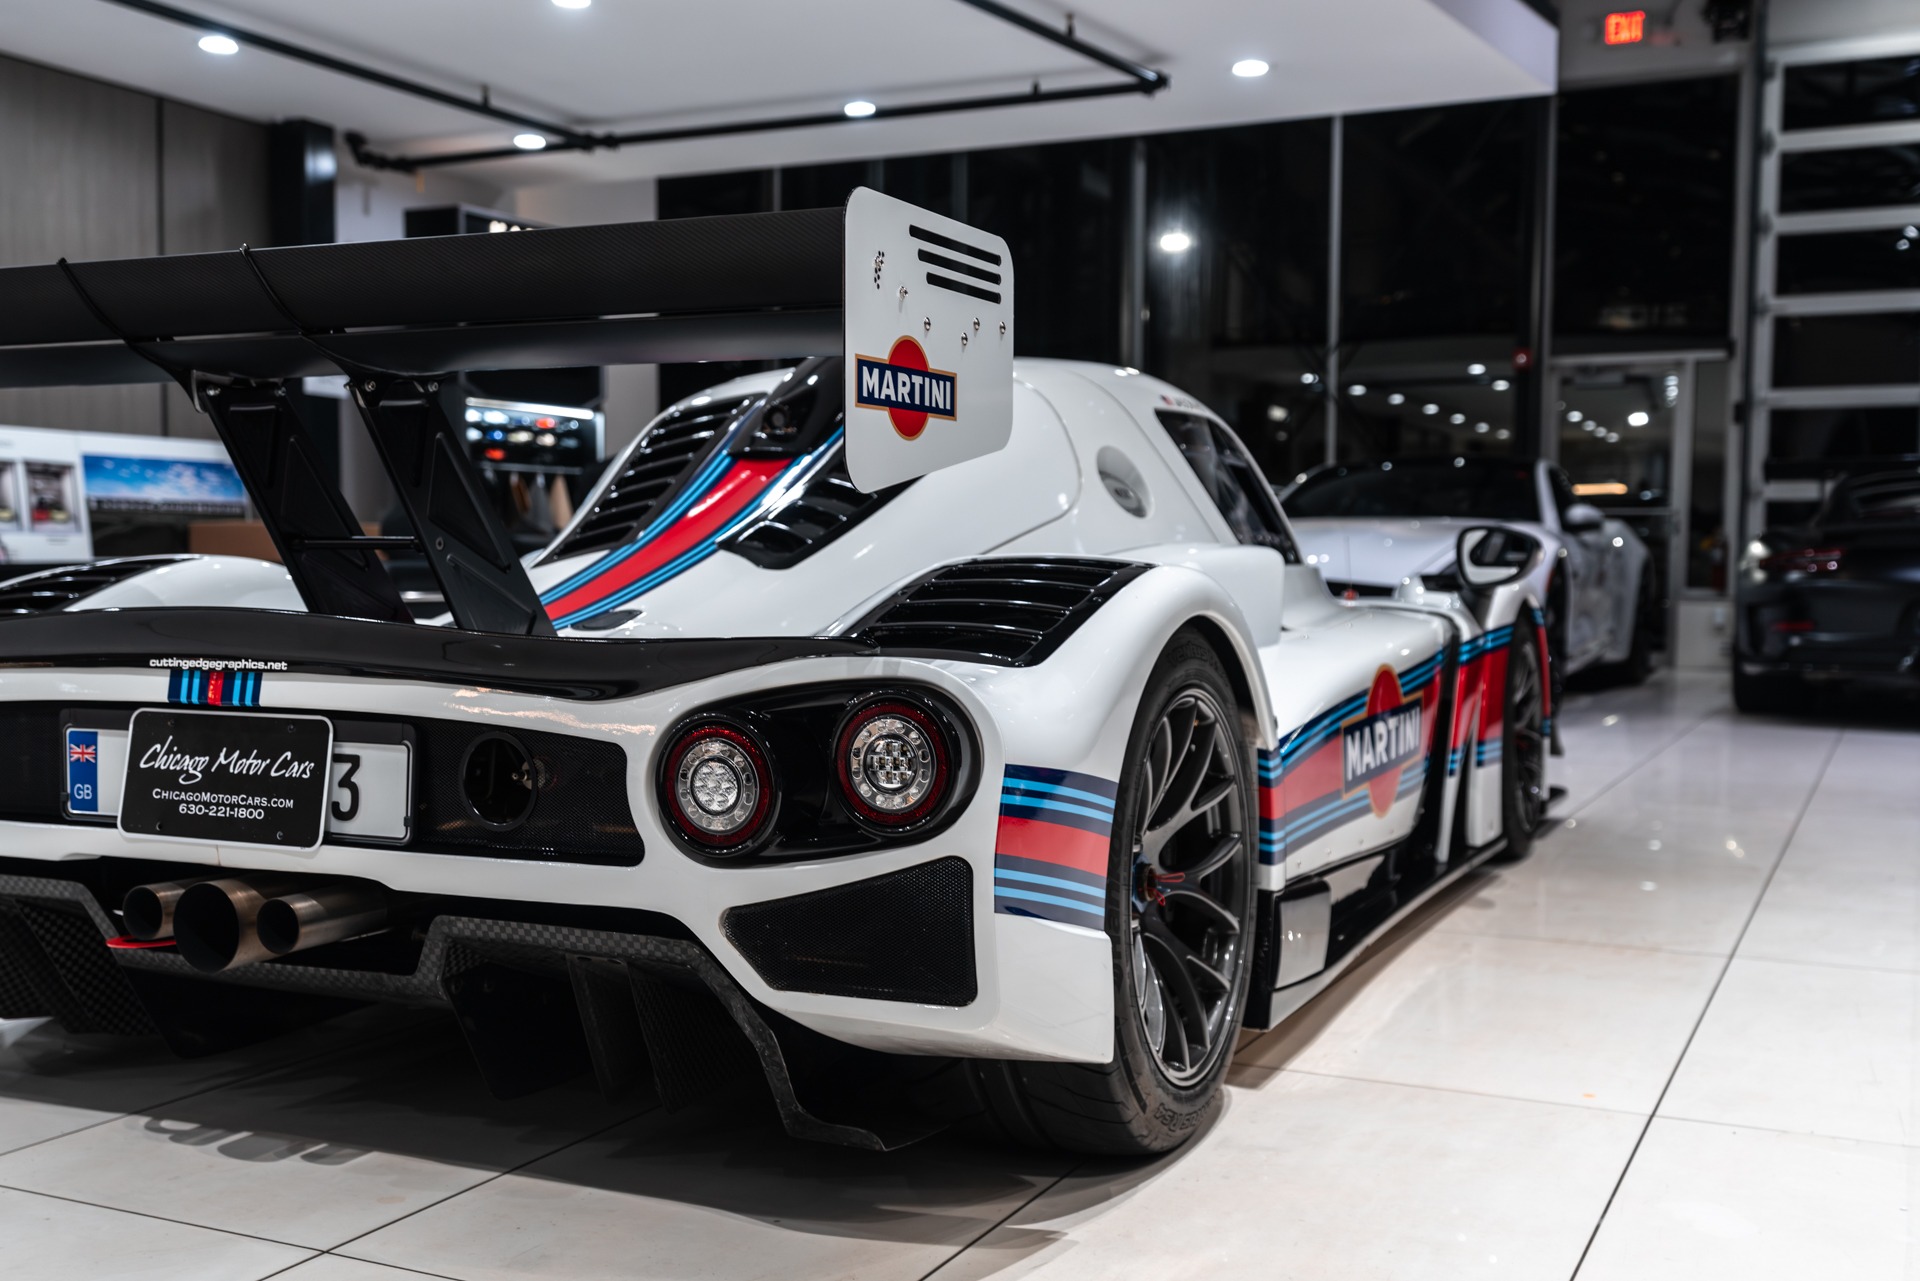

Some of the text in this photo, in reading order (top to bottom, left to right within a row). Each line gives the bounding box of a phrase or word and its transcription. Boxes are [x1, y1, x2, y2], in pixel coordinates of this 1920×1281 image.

[1604, 10, 1646, 45] EXIT
[861, 365, 952, 410] MARTINI
[149, 657, 288, 671] cuttingedgegraphics.net
[139, 735, 315, 785] Chicago Motor Cars
[1344, 704, 1422, 781] MARTINI
[74, 783, 93, 800] GB
[331, 753, 361, 822] 3
[178, 803, 265, 820] 630-221-1800
